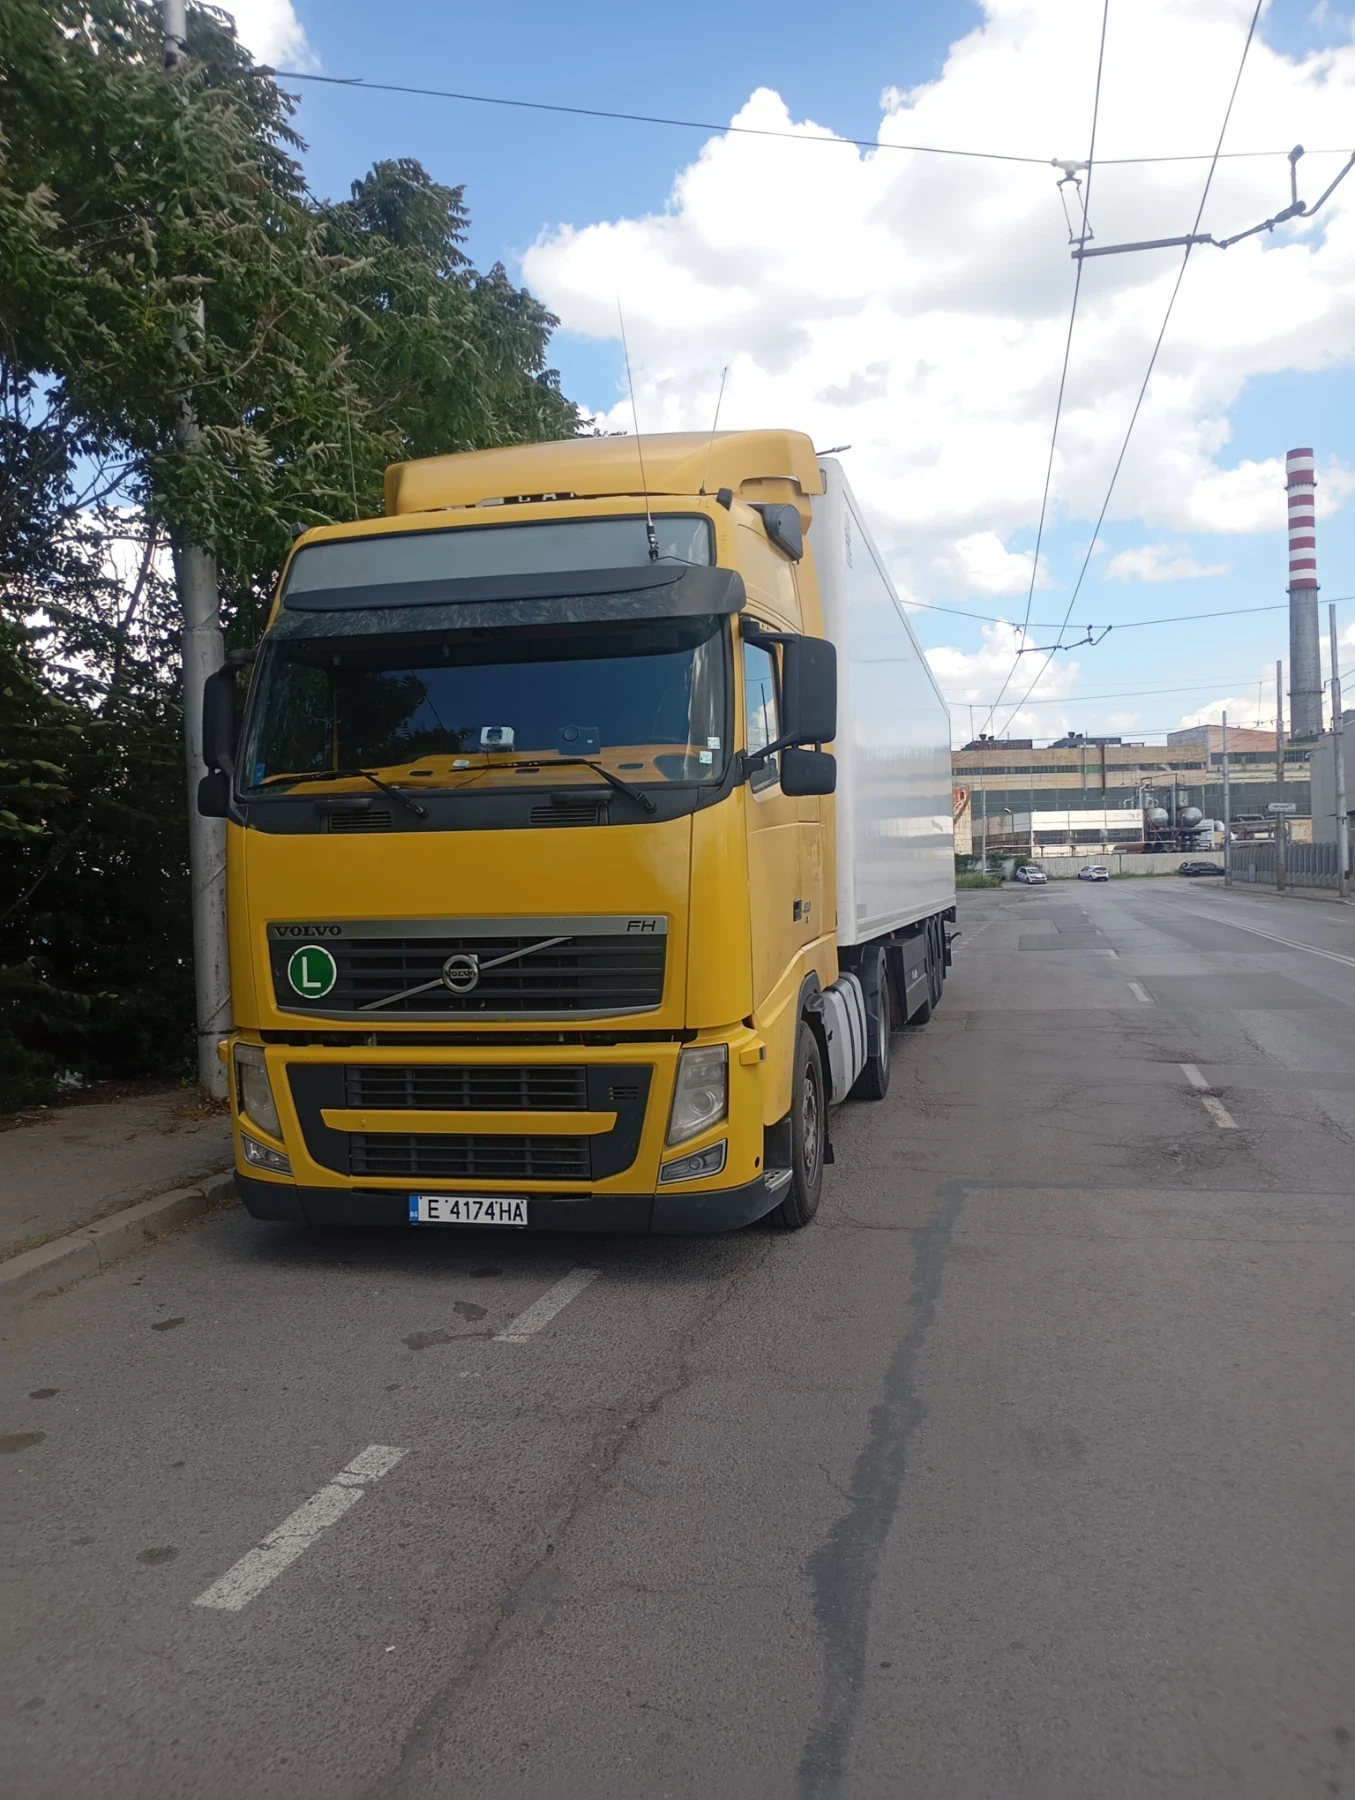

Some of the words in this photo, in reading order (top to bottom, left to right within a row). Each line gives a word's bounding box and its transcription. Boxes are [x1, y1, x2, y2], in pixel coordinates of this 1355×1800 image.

[274, 925, 342, 937] VOLVO
[626, 920, 657, 932] FH
[302, 956, 321, 988] L
[444, 970, 477, 978] VOLVO
